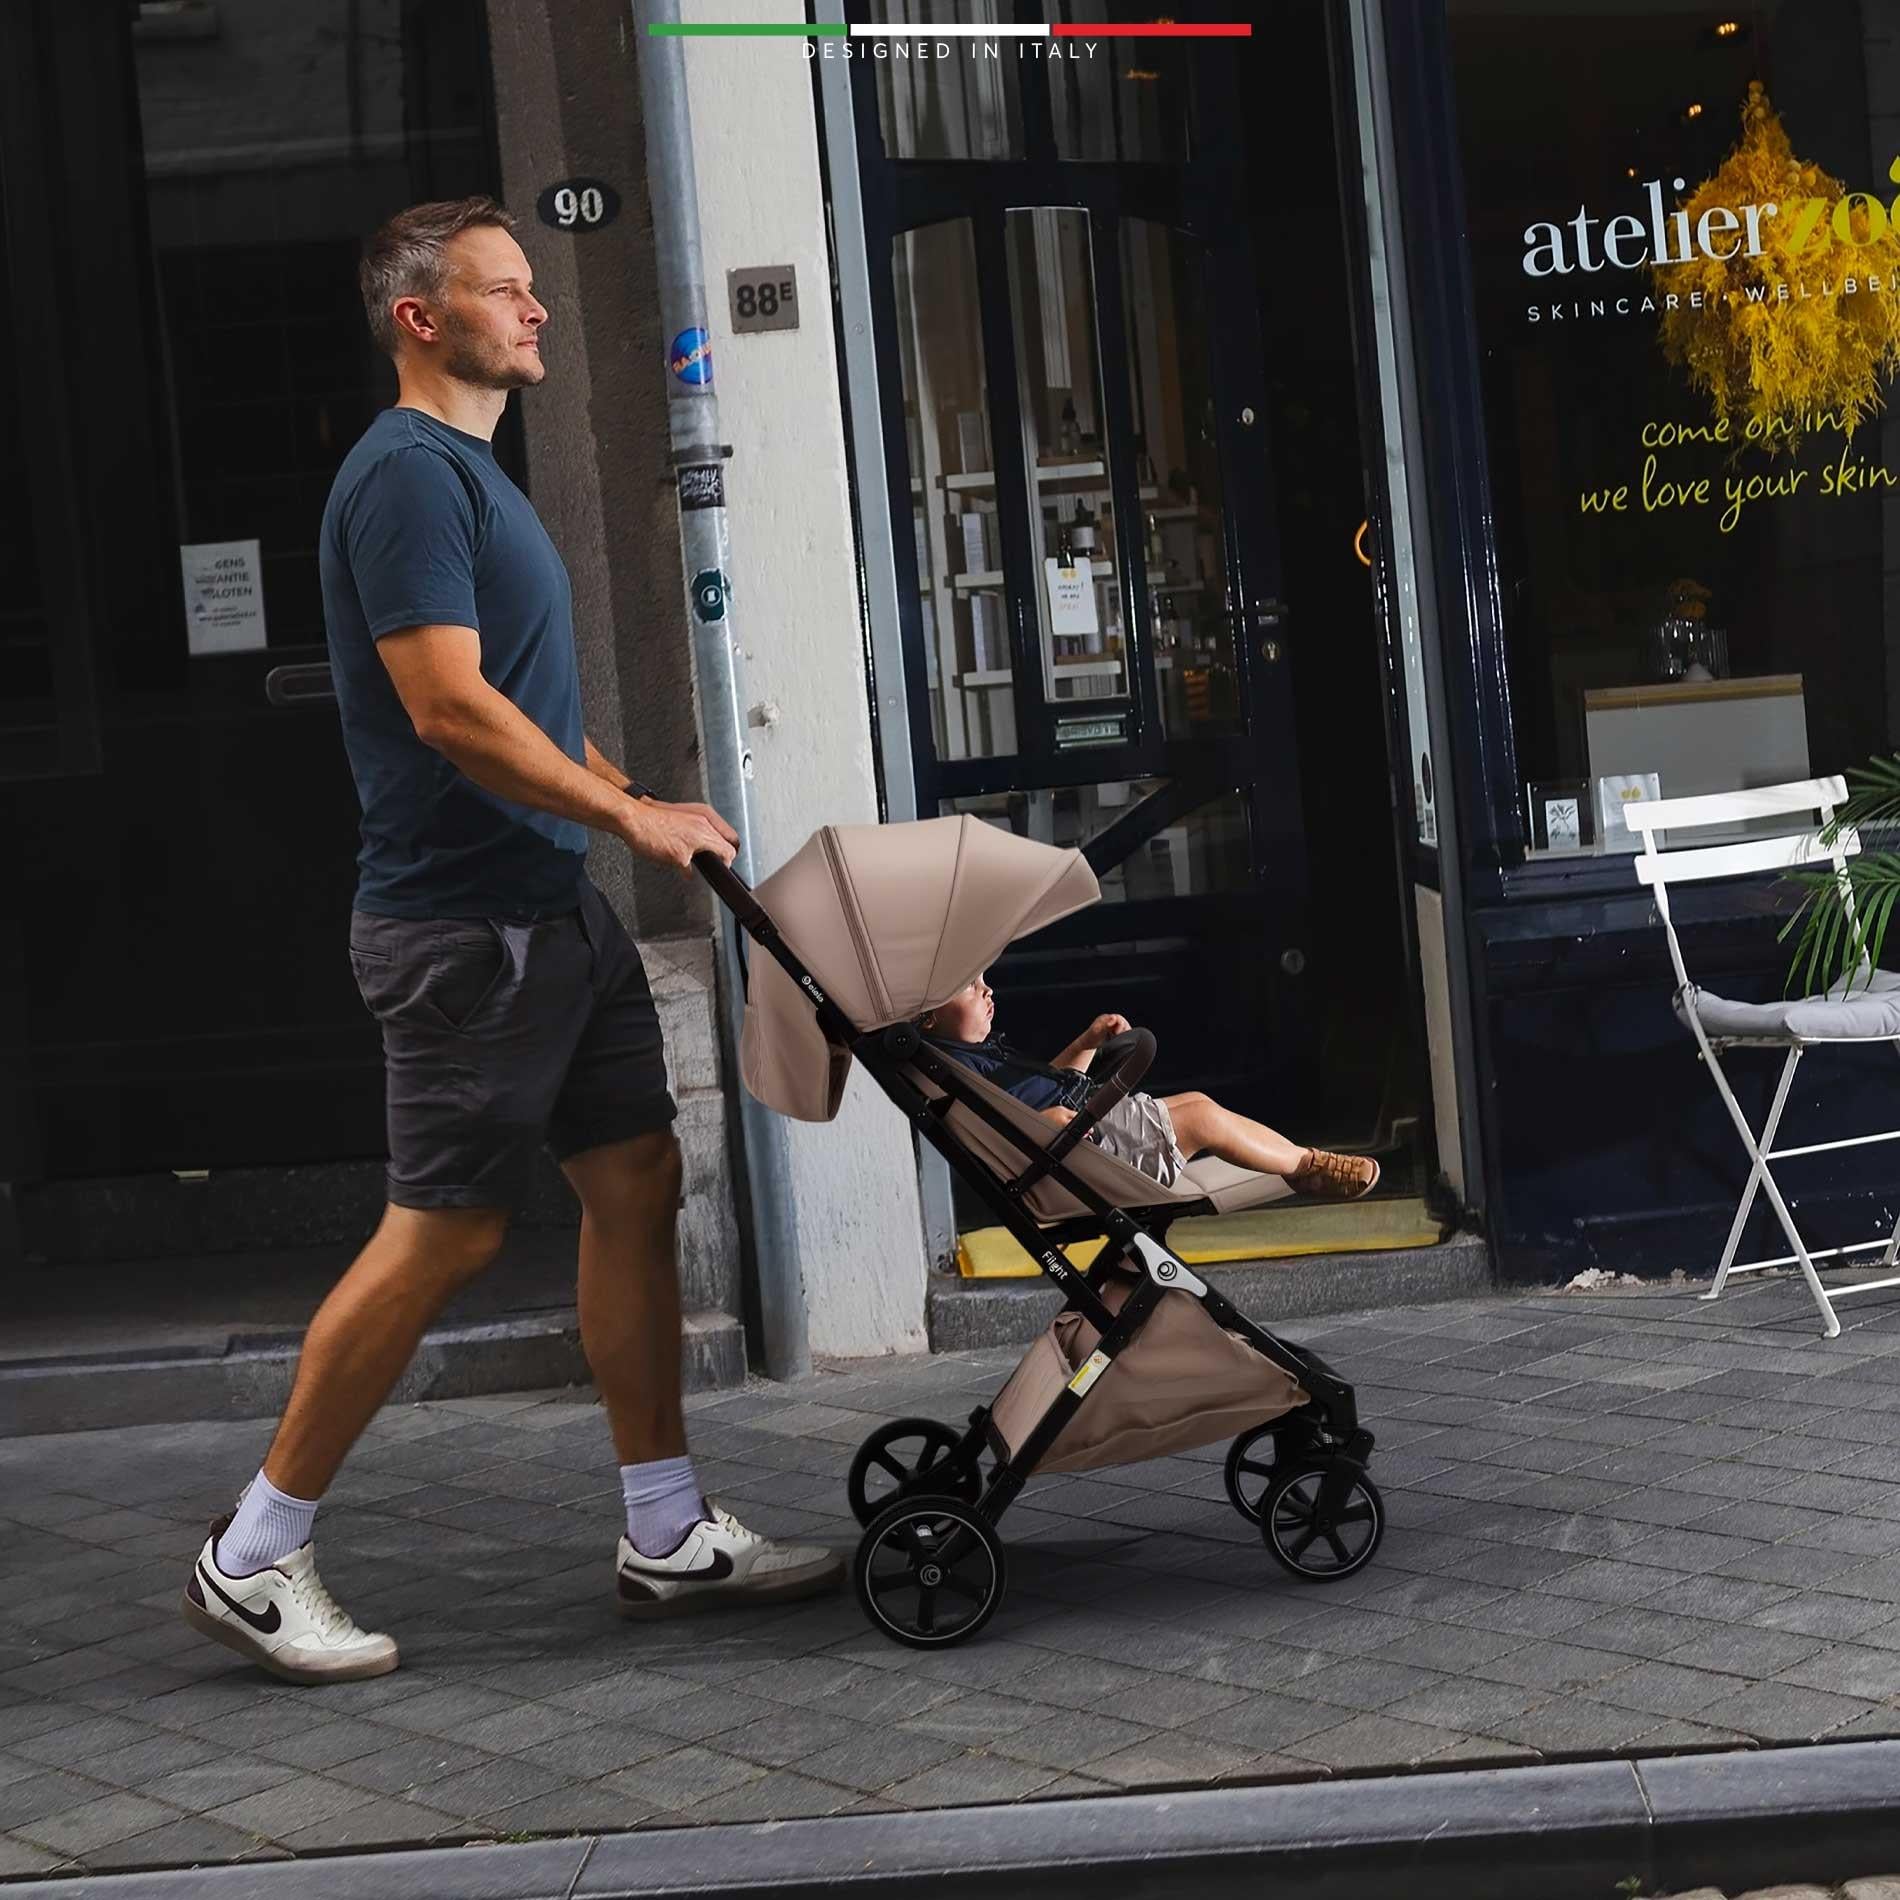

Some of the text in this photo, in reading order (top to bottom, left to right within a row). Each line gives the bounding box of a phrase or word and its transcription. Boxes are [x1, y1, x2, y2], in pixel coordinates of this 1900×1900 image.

[554, 188, 604, 225] 90
[1522, 155, 1900, 277] atelierzo
[1528, 291, 1703, 322] SKINCARE
[1642, 400, 1846, 447] come on in
[1581, 444, 1898, 533] we love your skin
[1041, 1250, 1068, 1280] Flight
